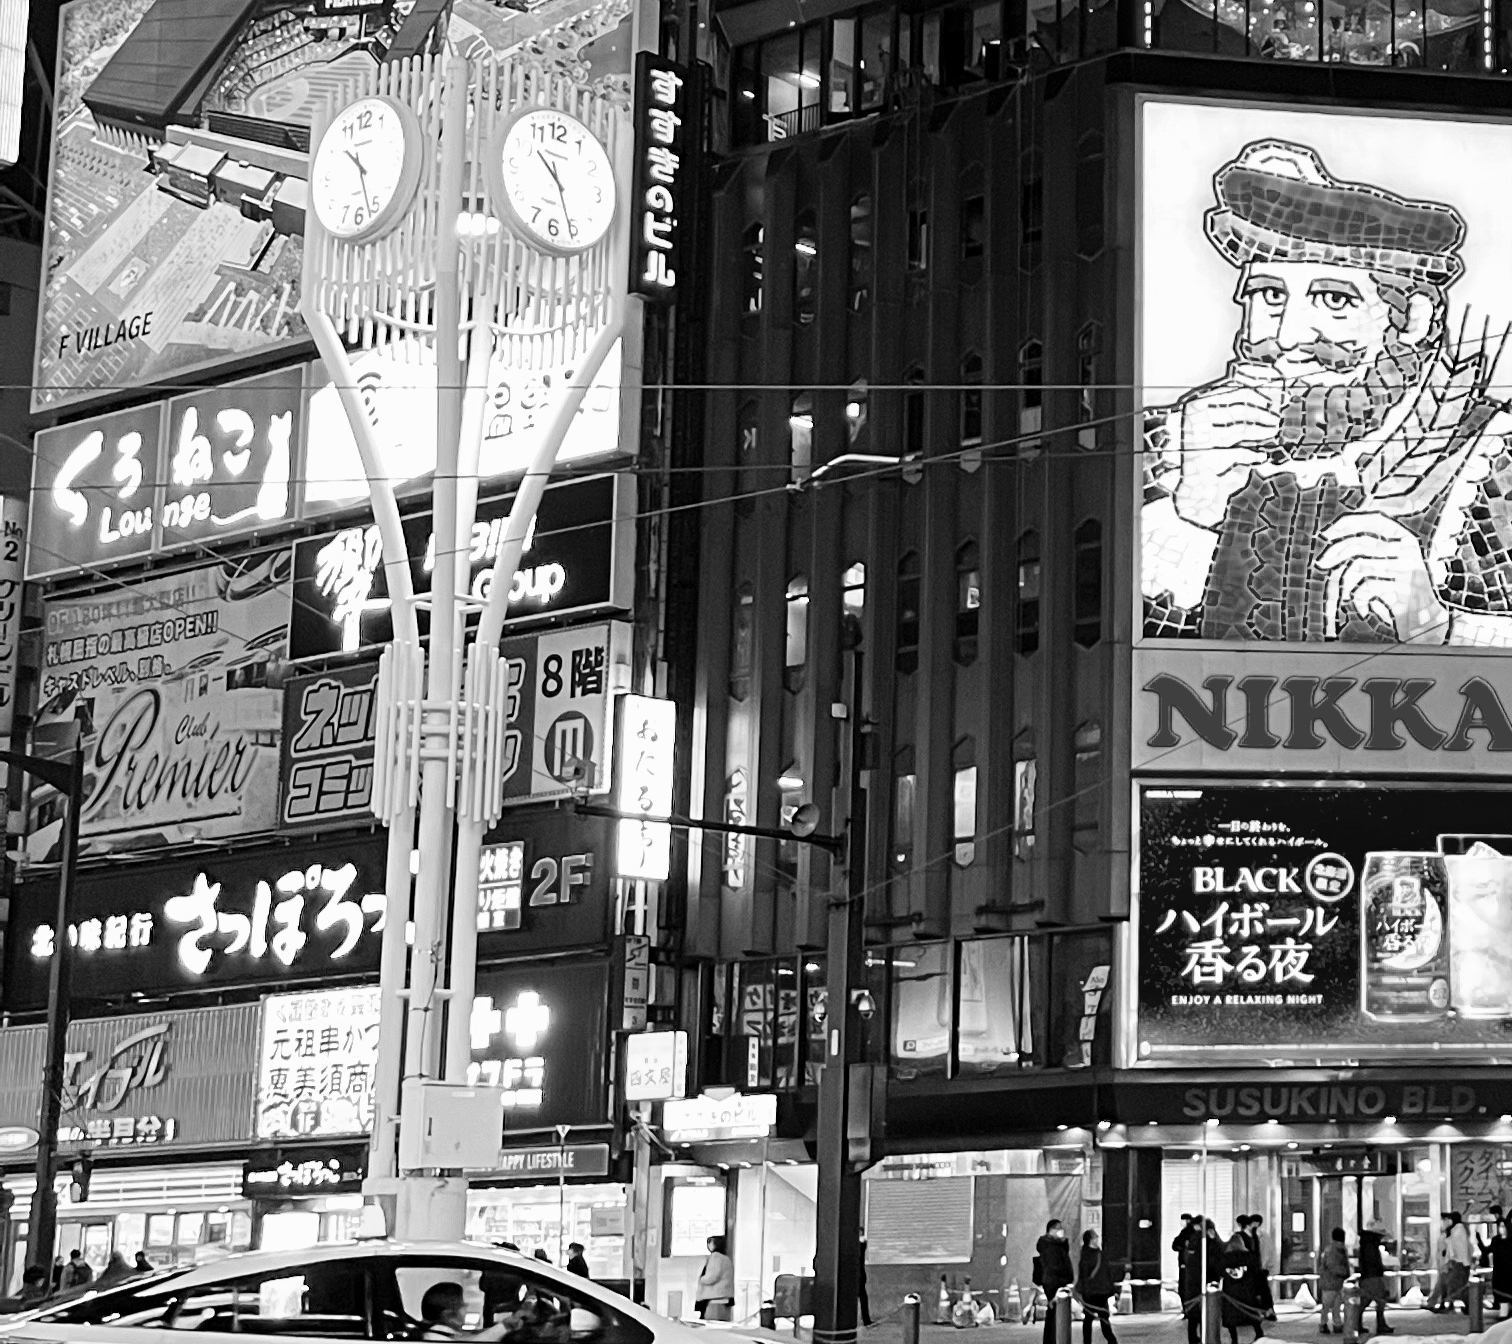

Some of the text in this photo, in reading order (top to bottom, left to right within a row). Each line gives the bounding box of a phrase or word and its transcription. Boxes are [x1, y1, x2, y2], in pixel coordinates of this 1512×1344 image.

[342, 122, 355, 141] 11
[356, 110, 373, 130] 12
[530, 122, 545, 143] 11
[548, 121, 568, 144] 12
[354, 207, 364, 226] 6
[531, 205, 542, 224] 7
[548, 217, 559, 237] 6
[58, 310, 154, 360] F VILLAGE
[99, 491, 213, 544] Lounge
[4, 540, 19, 562] 2
[471, 562, 567, 603] Goup
[541, 646, 605, 698] 8階
[175, 711, 211, 745] Club
[529, 852, 594, 907] 2F
[1194, 866, 1303, 893] BLACK
[1155, 901, 1338, 936] ハイボール
[1181, 940, 1315, 984] 香る夜
[1171, 994, 1324, 1006] ENJOY A RELAXING NIGHT
[268, 1060, 377, 1099] 恵美須商
[1182, 1085, 1487, 1117] SUSUKINO BLD.
[502, 1151, 575, 1170] APPY LIFESTYLE
